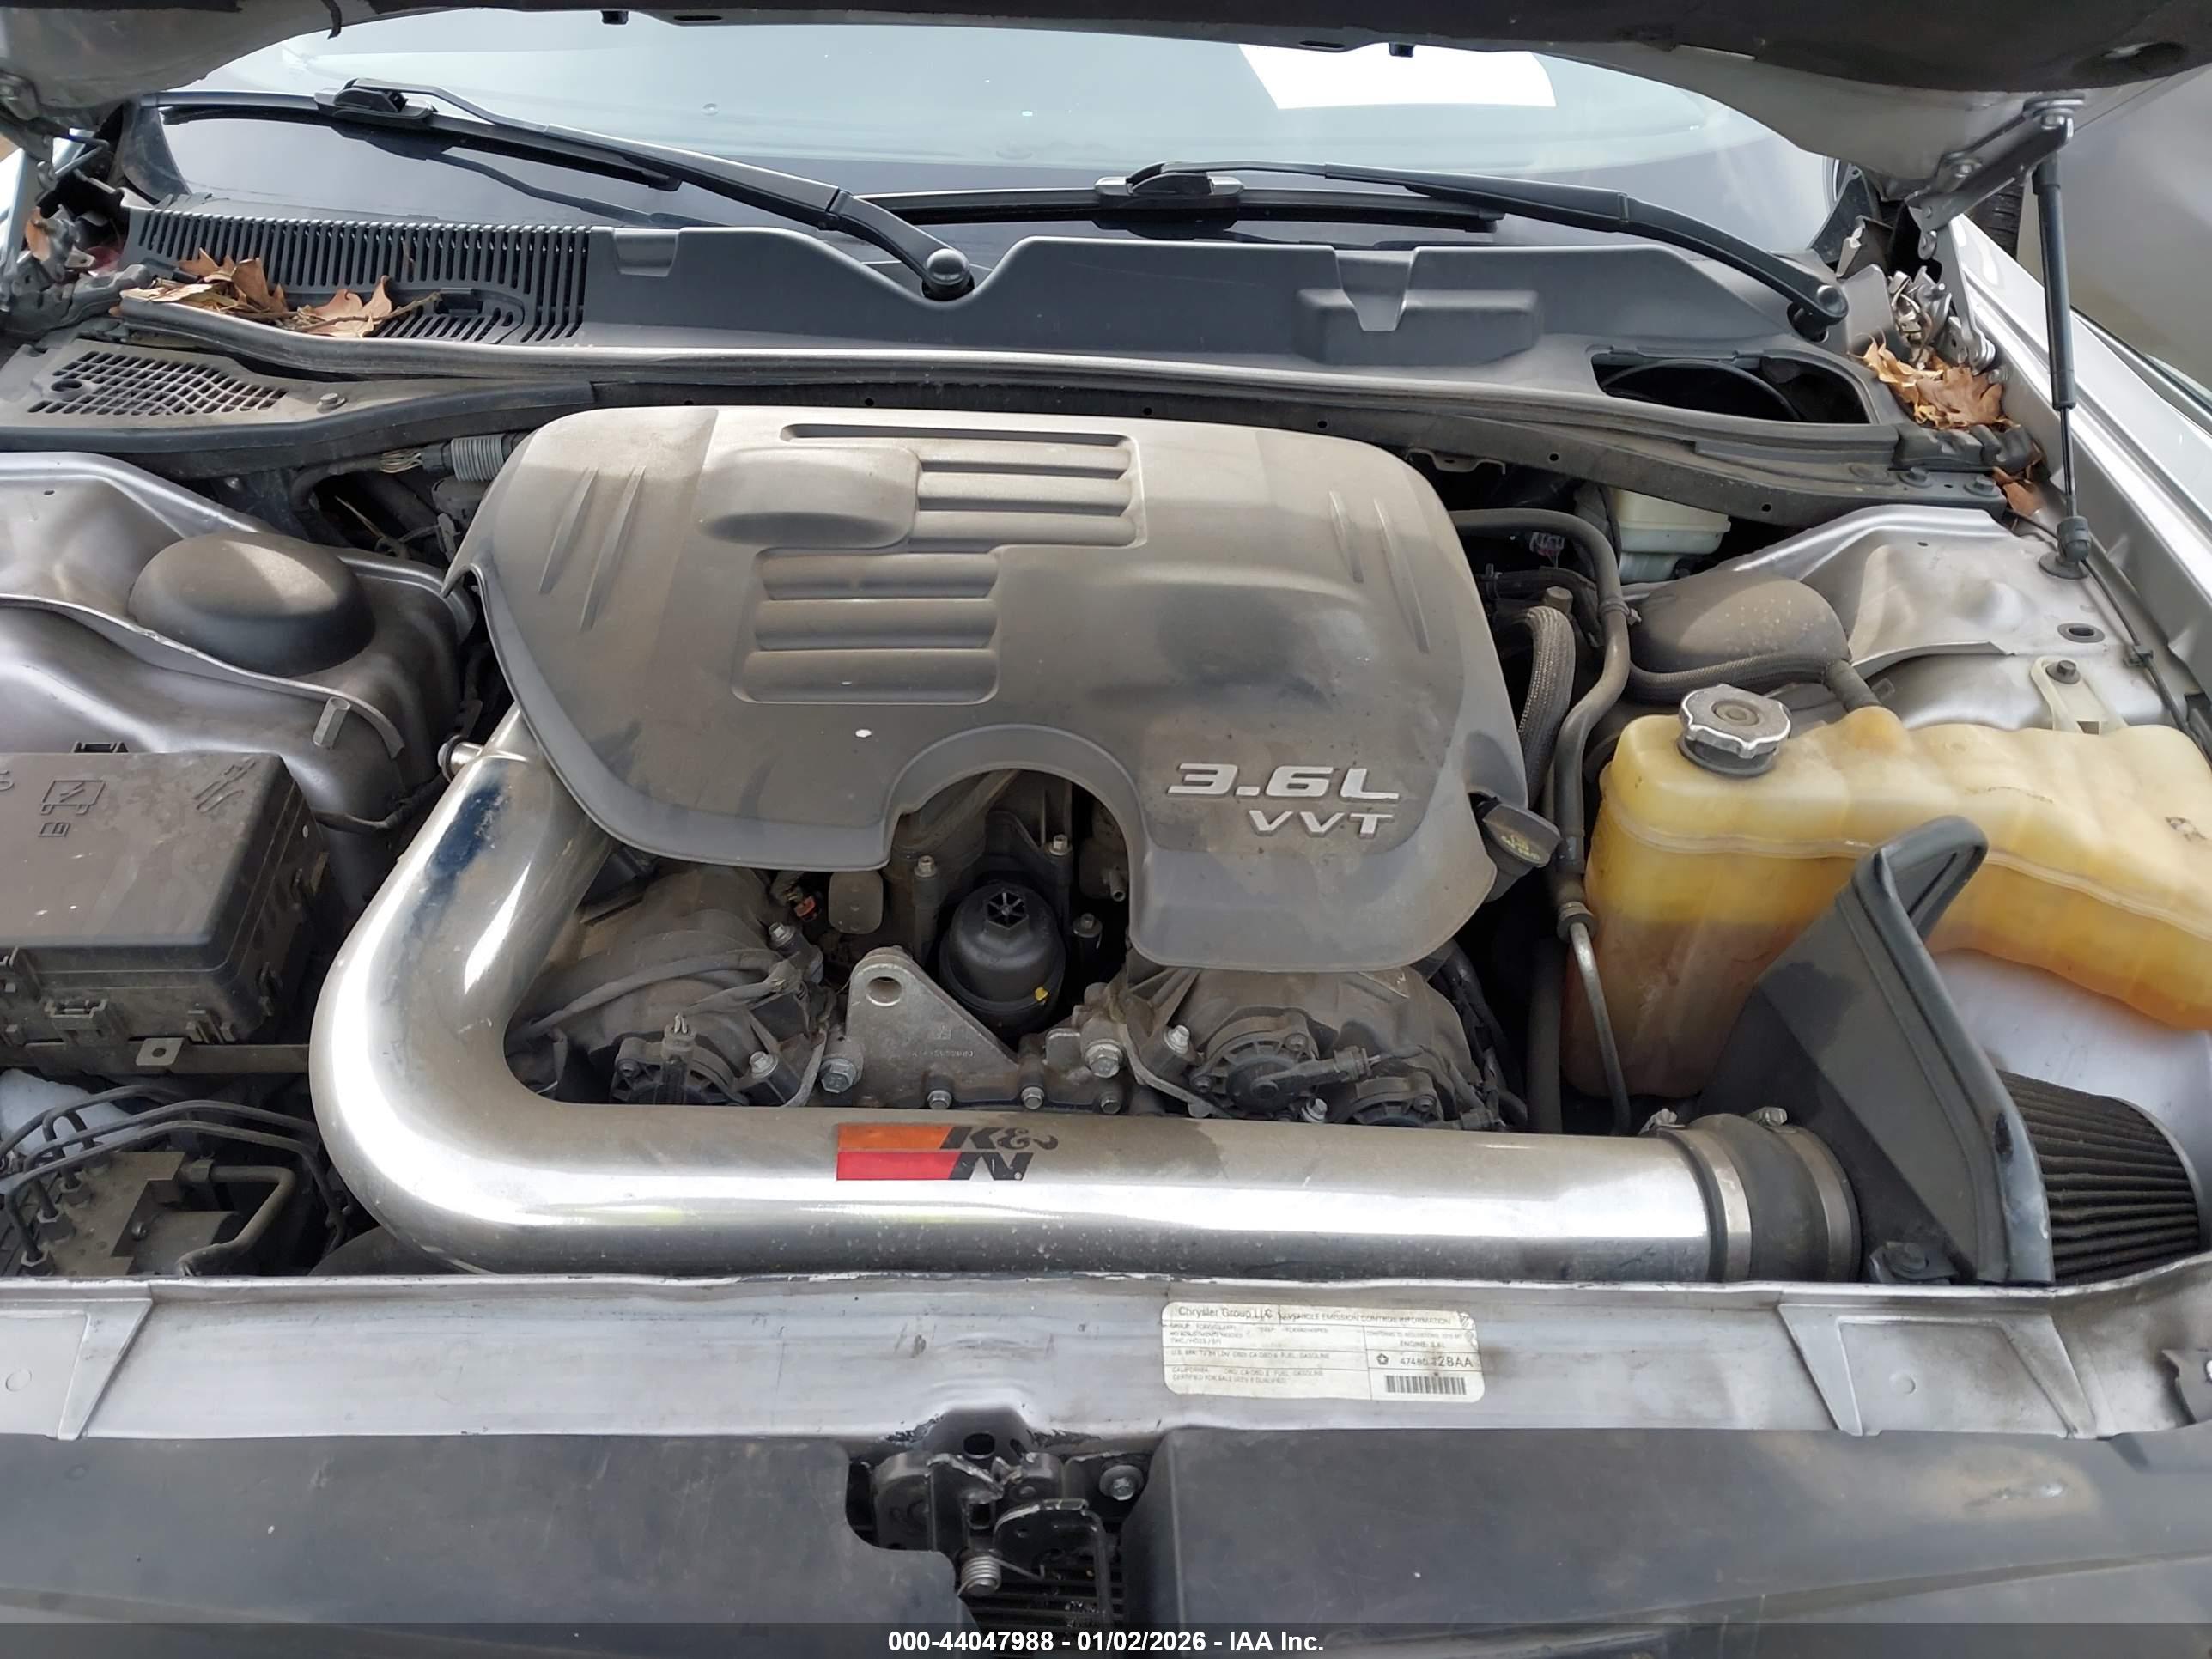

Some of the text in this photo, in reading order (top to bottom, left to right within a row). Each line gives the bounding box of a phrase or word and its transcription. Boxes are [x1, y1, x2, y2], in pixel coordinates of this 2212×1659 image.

[1168, 763, 1400, 801] 3.6L
[1249, 810, 1395, 837] VVT
[1178, 1306, 1218, 1319] Chrysler
[1221, 1307, 1252, 1320] Group
